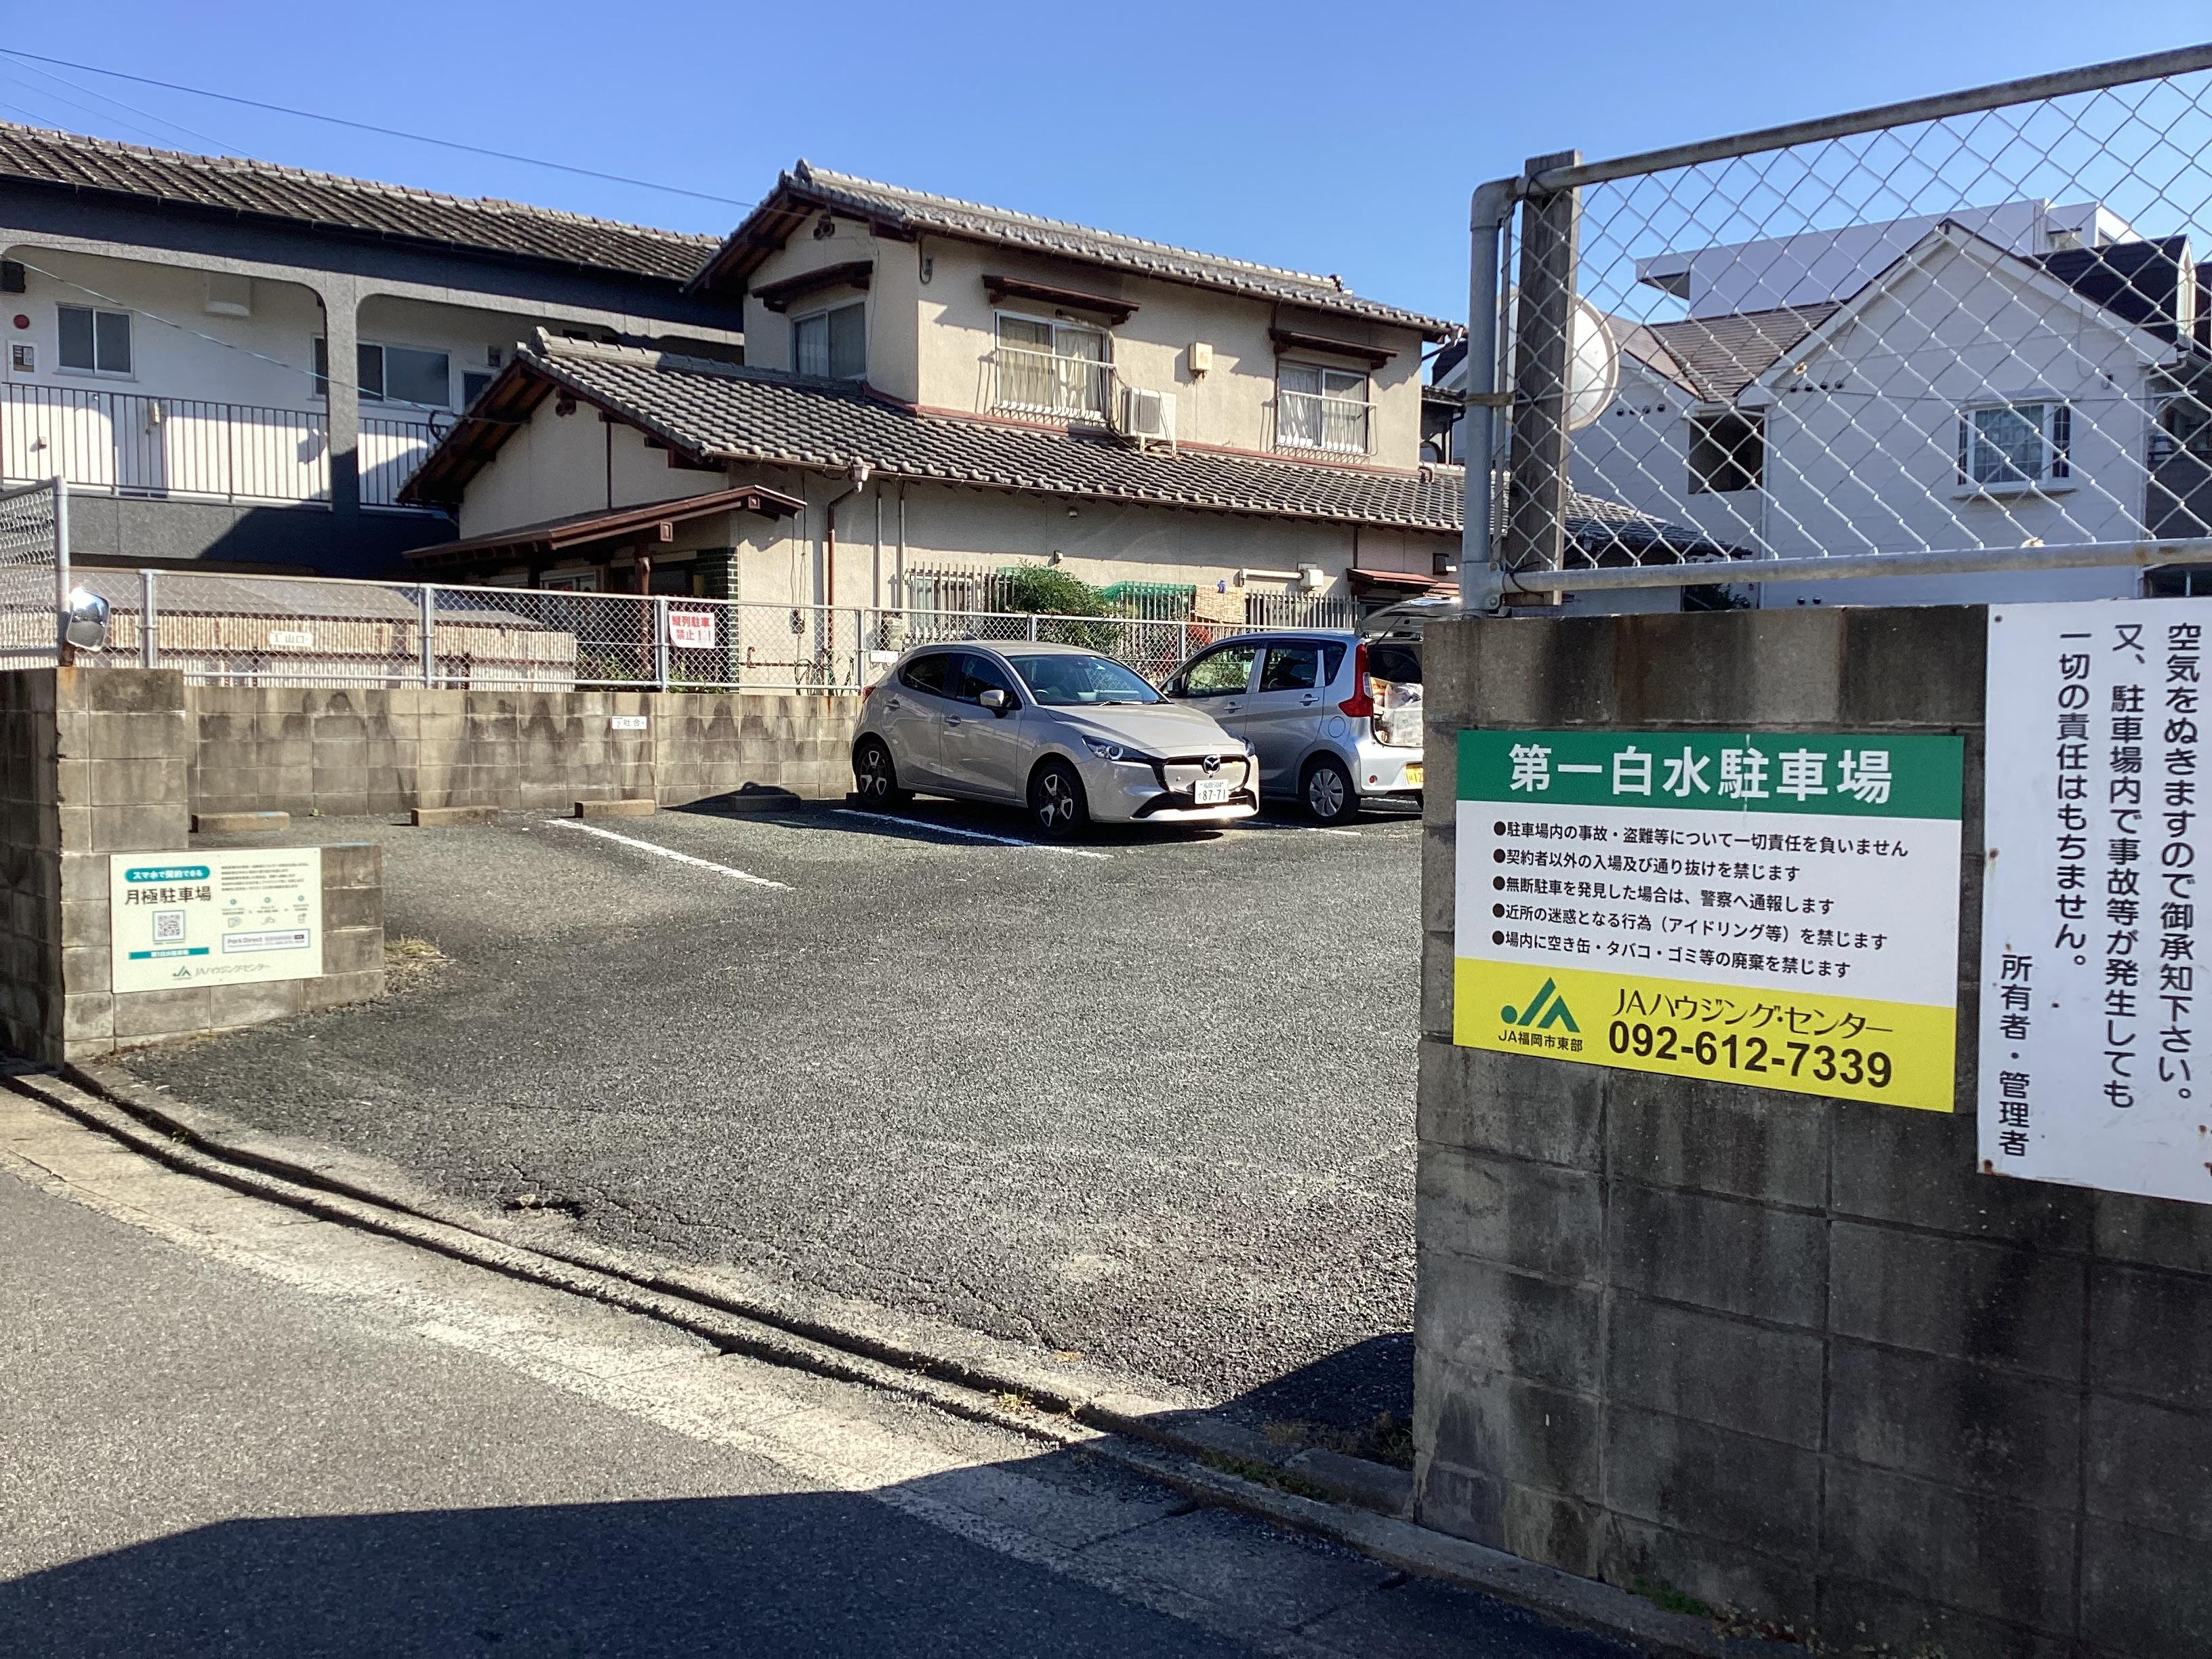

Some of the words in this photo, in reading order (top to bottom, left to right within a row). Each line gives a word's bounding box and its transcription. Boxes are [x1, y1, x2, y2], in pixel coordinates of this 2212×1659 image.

[1203, 790, 1225, 801] 87-71
[1508, 743, 1893, 804] 第一白水駐車場
[2055, 633, 2092, 966] 一切の責任はもちません。
[2158, 622, 2201, 1099] 空気をぬきますので御承知下さい。
[124, 885, 211, 905] 月極駐車場
[1498, 1029, 1584, 1052] JA福岡市東部
[1609, 1020, 1892, 1088] 092-612-7339
[1999, 954, 2032, 1158] 所有者・管理者
